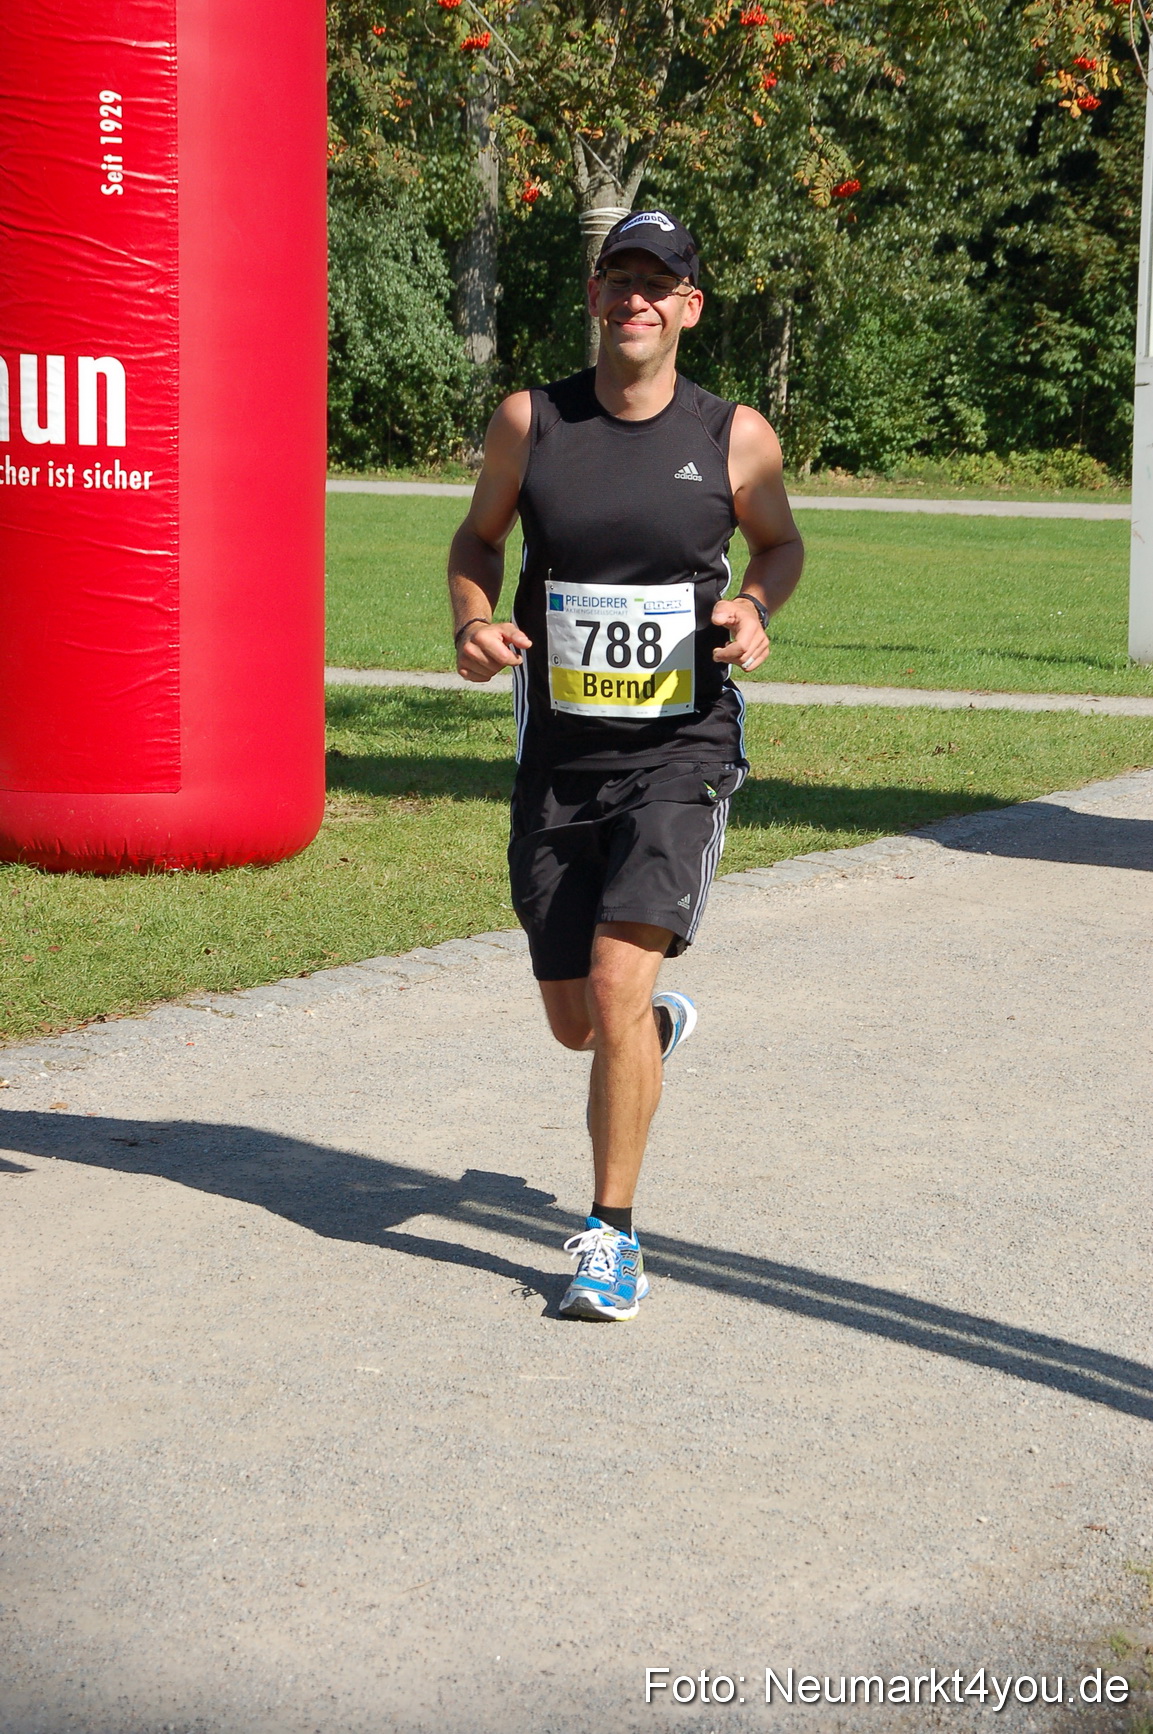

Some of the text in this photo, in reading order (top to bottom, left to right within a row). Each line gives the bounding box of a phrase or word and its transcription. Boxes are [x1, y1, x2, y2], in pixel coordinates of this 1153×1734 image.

[98, 90, 124, 196] Seit 1929
[0, 353, 127, 447] un
[48, 460, 75, 488] ist
[82, 459, 154, 490] sicher
[674, 472, 703, 482] adidas
[565, 594, 628, 609] PFLEIDERER
[575, 619, 663, 669] 788
[583, 672, 656, 699] Bernd
